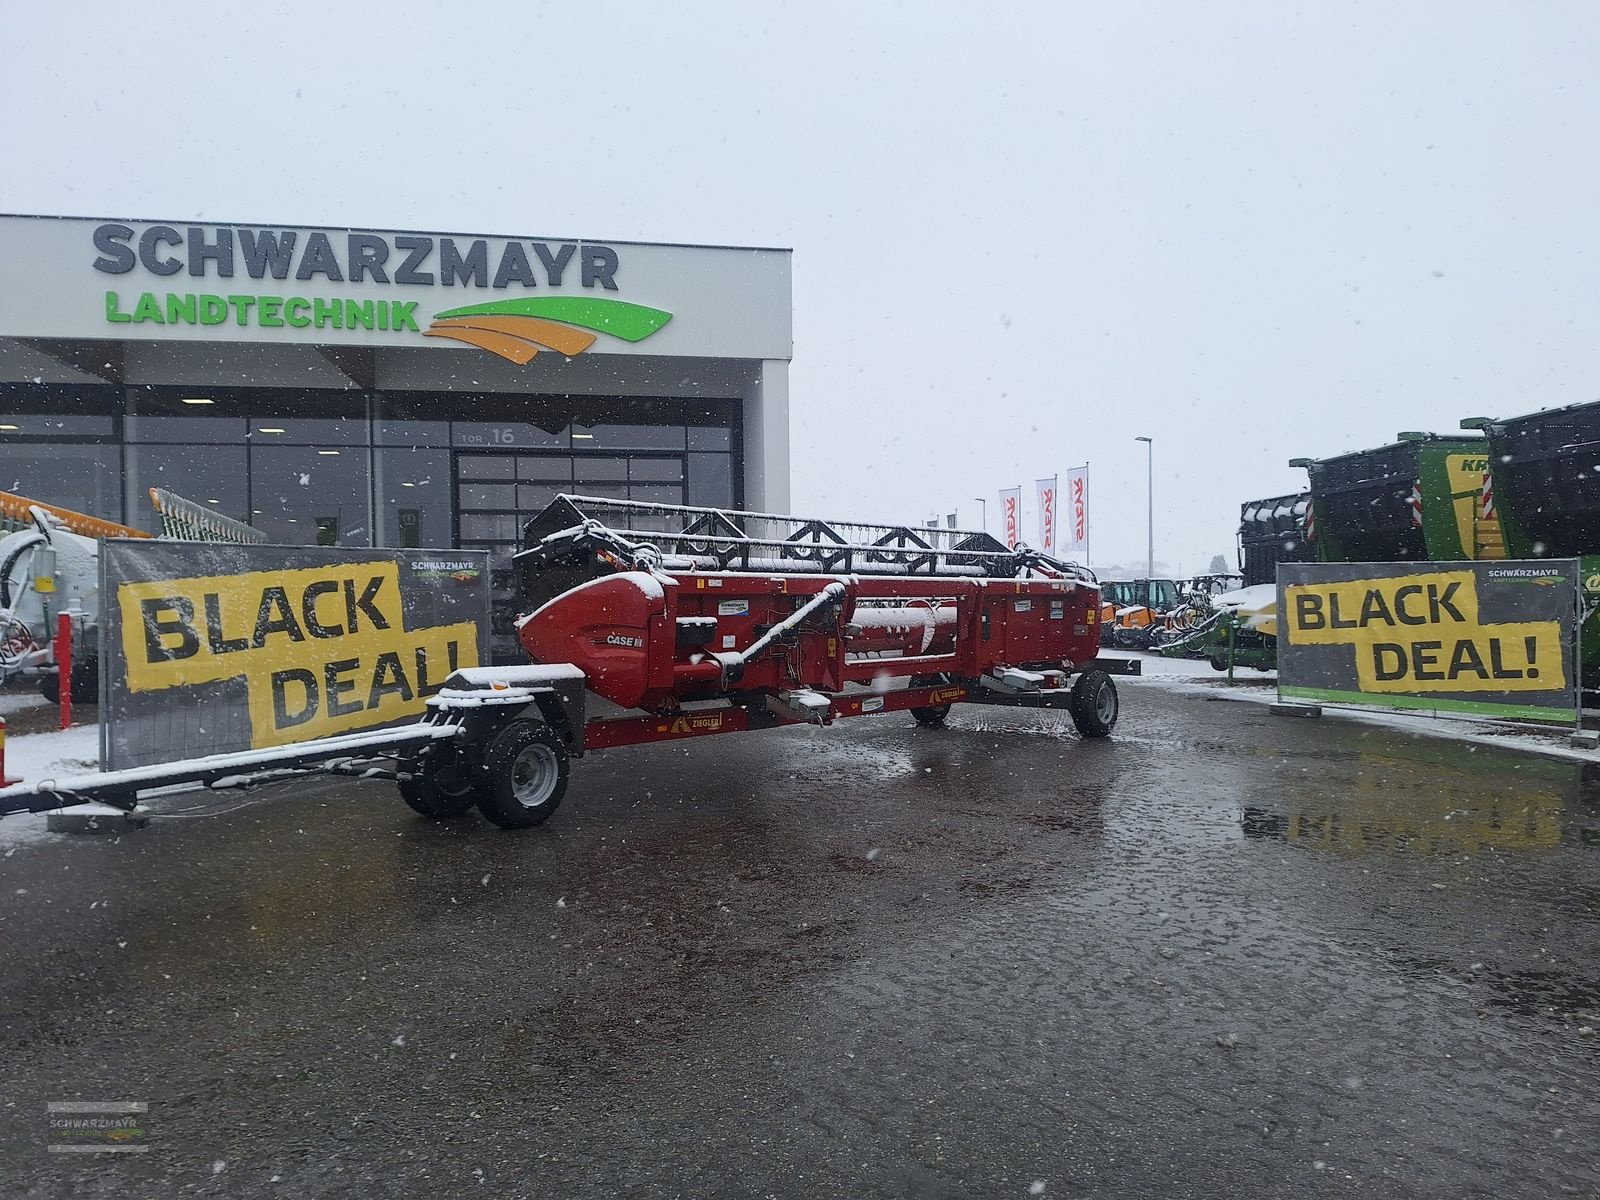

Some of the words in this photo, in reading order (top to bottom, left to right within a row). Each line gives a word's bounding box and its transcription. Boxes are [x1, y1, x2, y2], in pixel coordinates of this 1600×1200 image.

[92, 223, 618, 291] SCHWARZMAYR
[105, 290, 420, 331] LANDTECHNIK
[462, 435, 483, 443] TOR
[492, 428, 515, 444] 16
[411, 561, 475, 571] SCHWARZMAYR
[1488, 568, 1559, 577] SCHWARZMAYR
[140, 576, 390, 663] BLACK
[1295, 581, 1466, 631] BLACK
[607, 634, 634, 647] CASE
[1372, 636, 1540, 682] DEAL!
[692, 718, 719, 728] ZIEGLER
